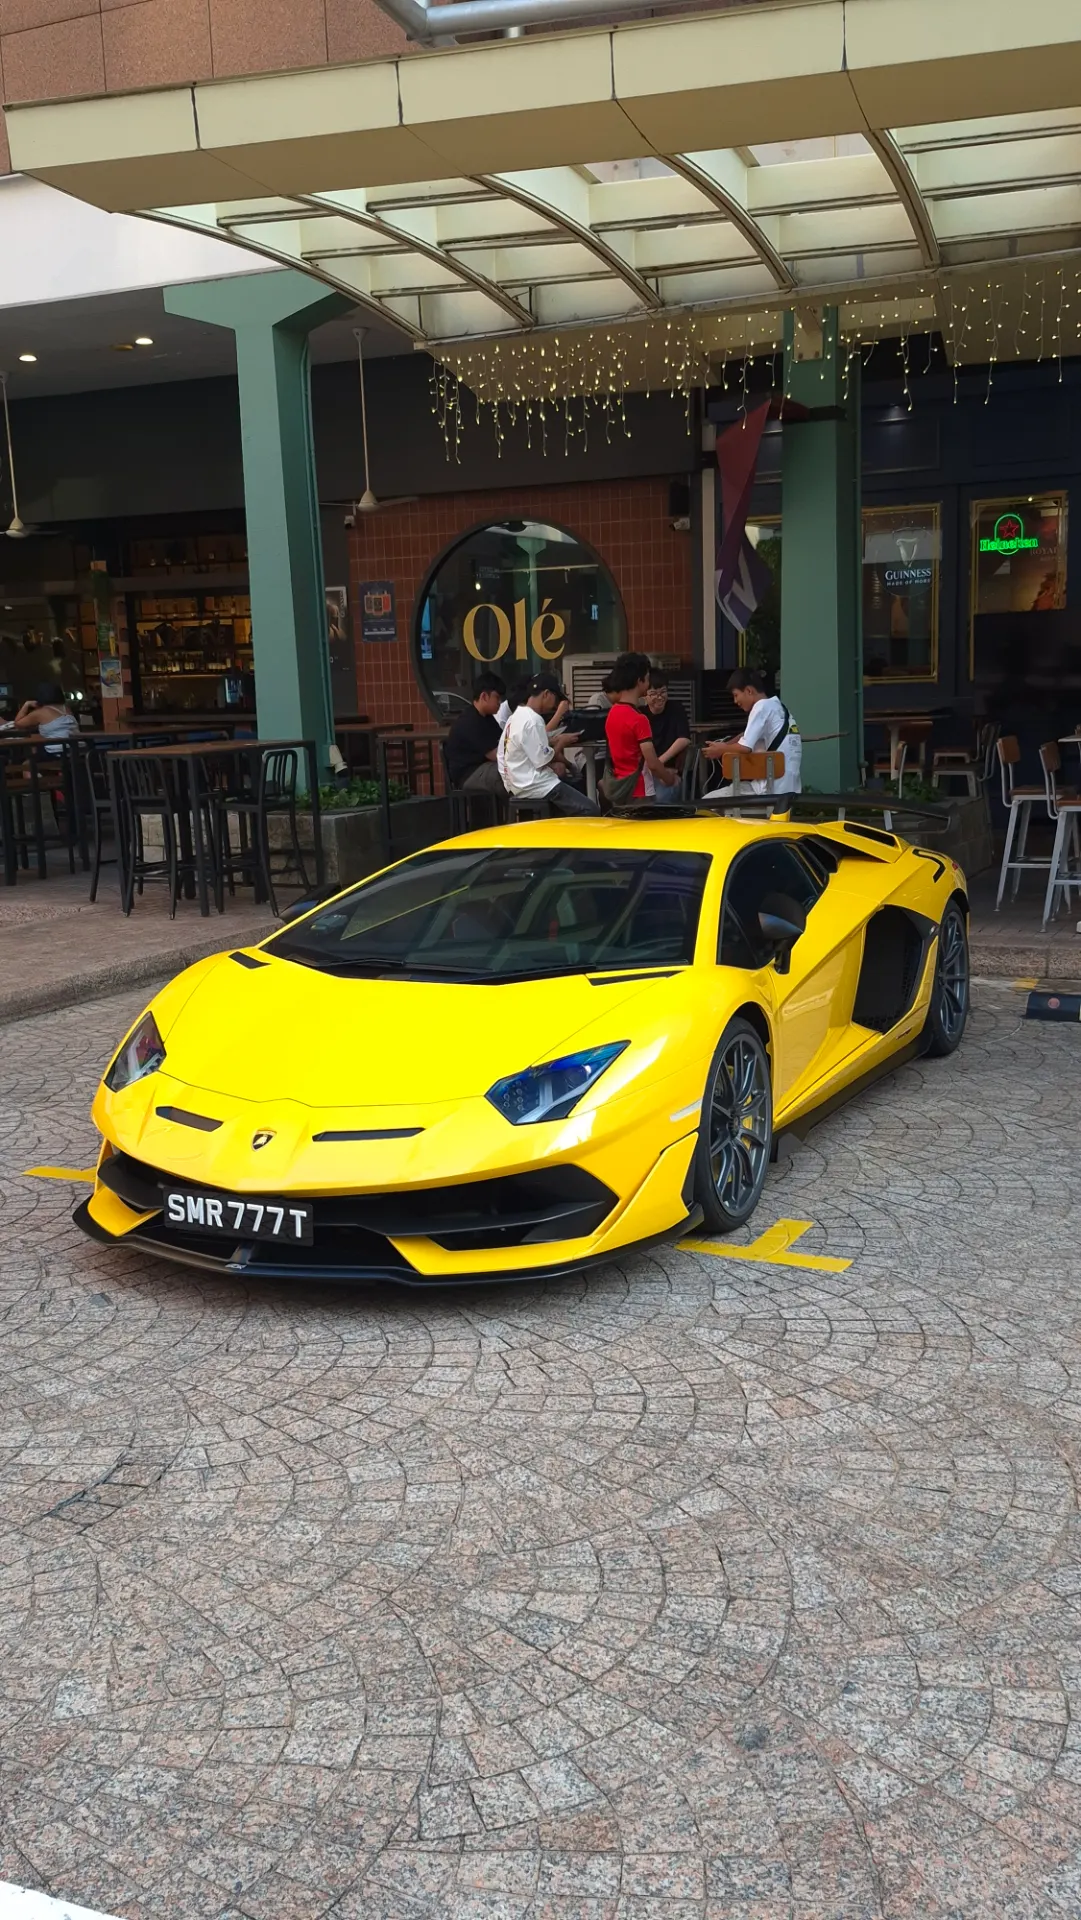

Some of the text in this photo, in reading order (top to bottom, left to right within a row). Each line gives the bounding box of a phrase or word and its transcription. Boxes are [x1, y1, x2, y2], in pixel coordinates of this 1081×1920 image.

[980, 538, 1039, 551] Heineken
[885, 568, 931, 580] GUINNESS
[462, 598, 566, 662] Olé
